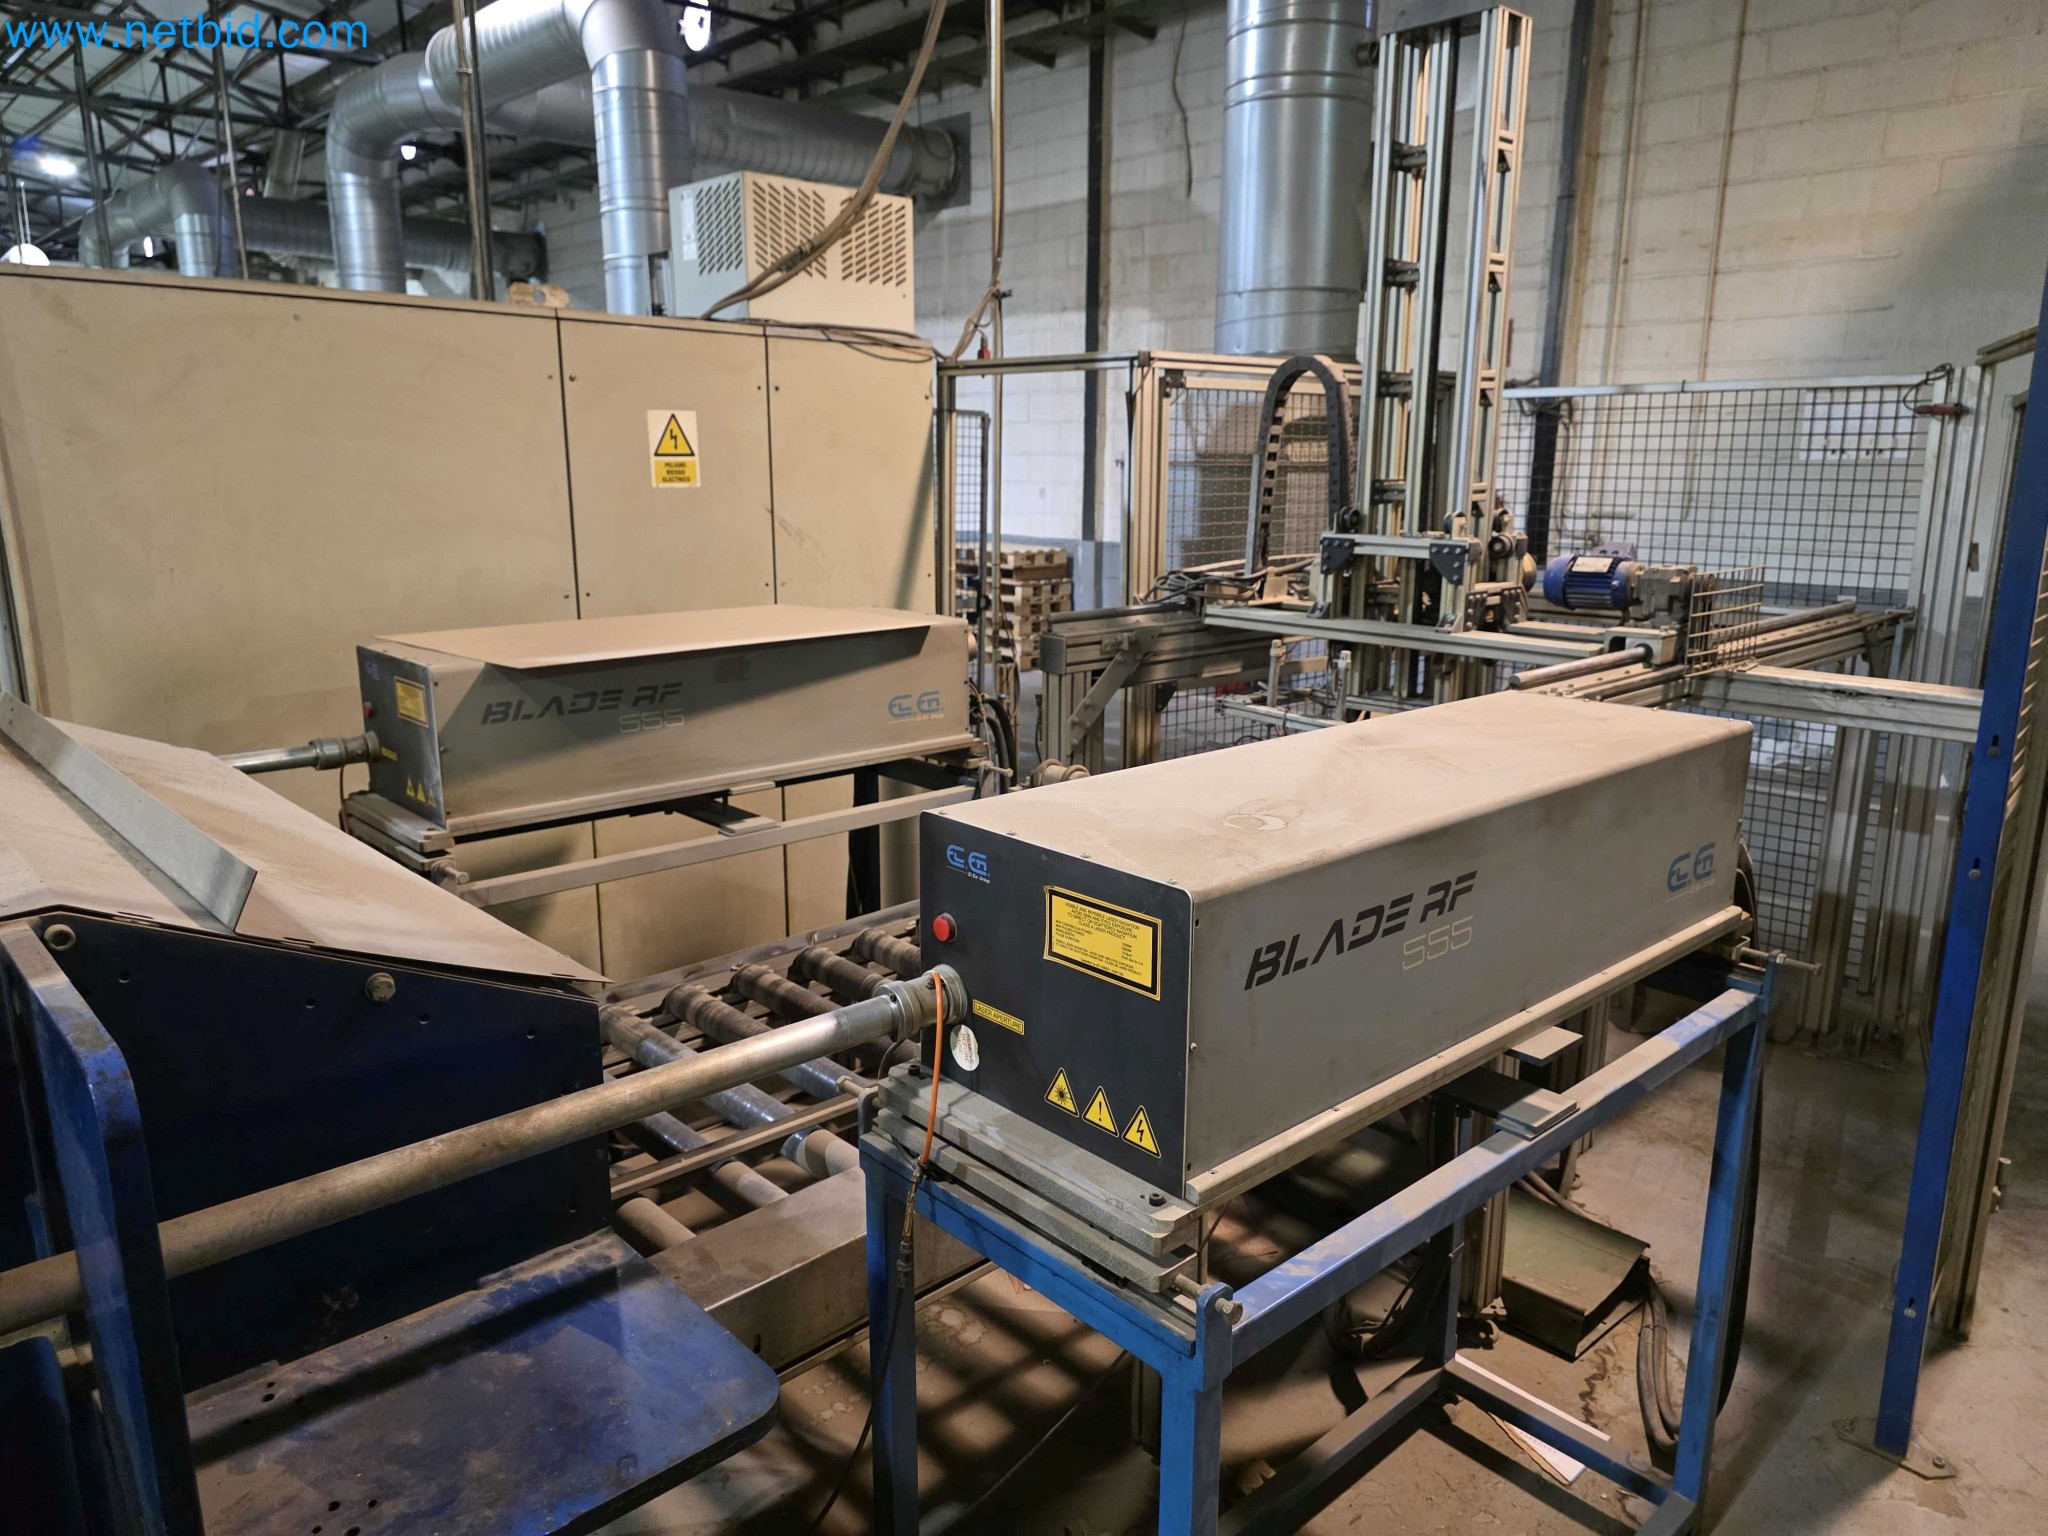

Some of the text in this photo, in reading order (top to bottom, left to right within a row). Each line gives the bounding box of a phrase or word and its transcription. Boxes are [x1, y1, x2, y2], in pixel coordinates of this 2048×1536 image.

[481, 681, 683, 725] BLADE RF
[619, 708, 685, 734] 555
[1074, 914, 1087, 922] DIRECT
[1116, 928, 1137, 939] RADIATION
[1078, 920, 1090, 928] CLASS
[1107, 930, 1125, 940] PRODUCT
[1119, 920, 1139, 930] RADIATION
[1244, 870, 1478, 991] BLADE RF
[1402, 915, 1474, 971] 555
[976, 1004, 1022, 1031] LASER APERTURE
